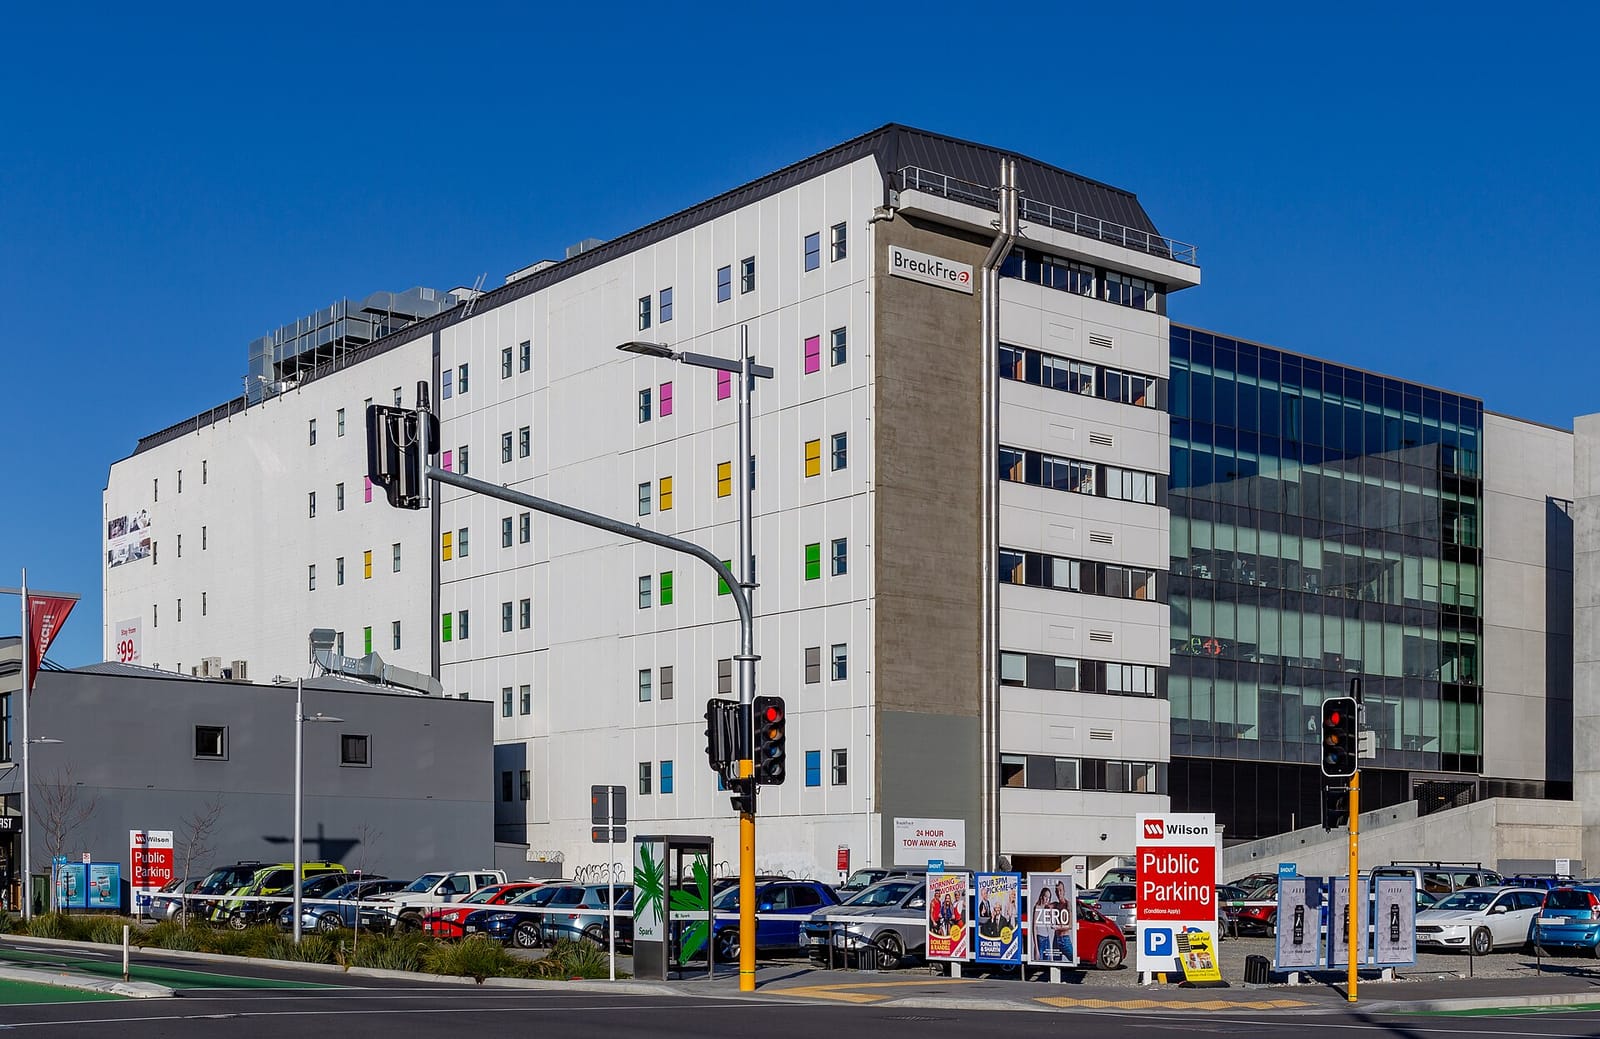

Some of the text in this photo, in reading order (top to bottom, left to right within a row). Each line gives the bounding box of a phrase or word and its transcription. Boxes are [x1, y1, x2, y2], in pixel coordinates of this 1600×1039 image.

[894, 251, 970, 283] BreakFree
[916, 829, 924, 837] 24
[1166, 824, 1208, 835] Wilson
[147, 836, 170, 844] Wilson
[903, 839, 918, 847] TOW
[939, 840, 957, 848] AREA
[135, 852, 165, 864] Public
[1143, 853, 1199, 874] Public
[135, 866, 170, 880] Parking
[929, 877, 955, 891] MORNING
[939, 881, 966, 895] WORKOUT
[979, 879, 995, 889] YOUR
[986, 882, 1017, 895] PICK-ME-UP
[1143, 881, 1210, 906] Parking
[1035, 908, 1069, 925] ZERO
[638, 927, 653, 936] Spark
[1150, 932, 1167, 952] P
